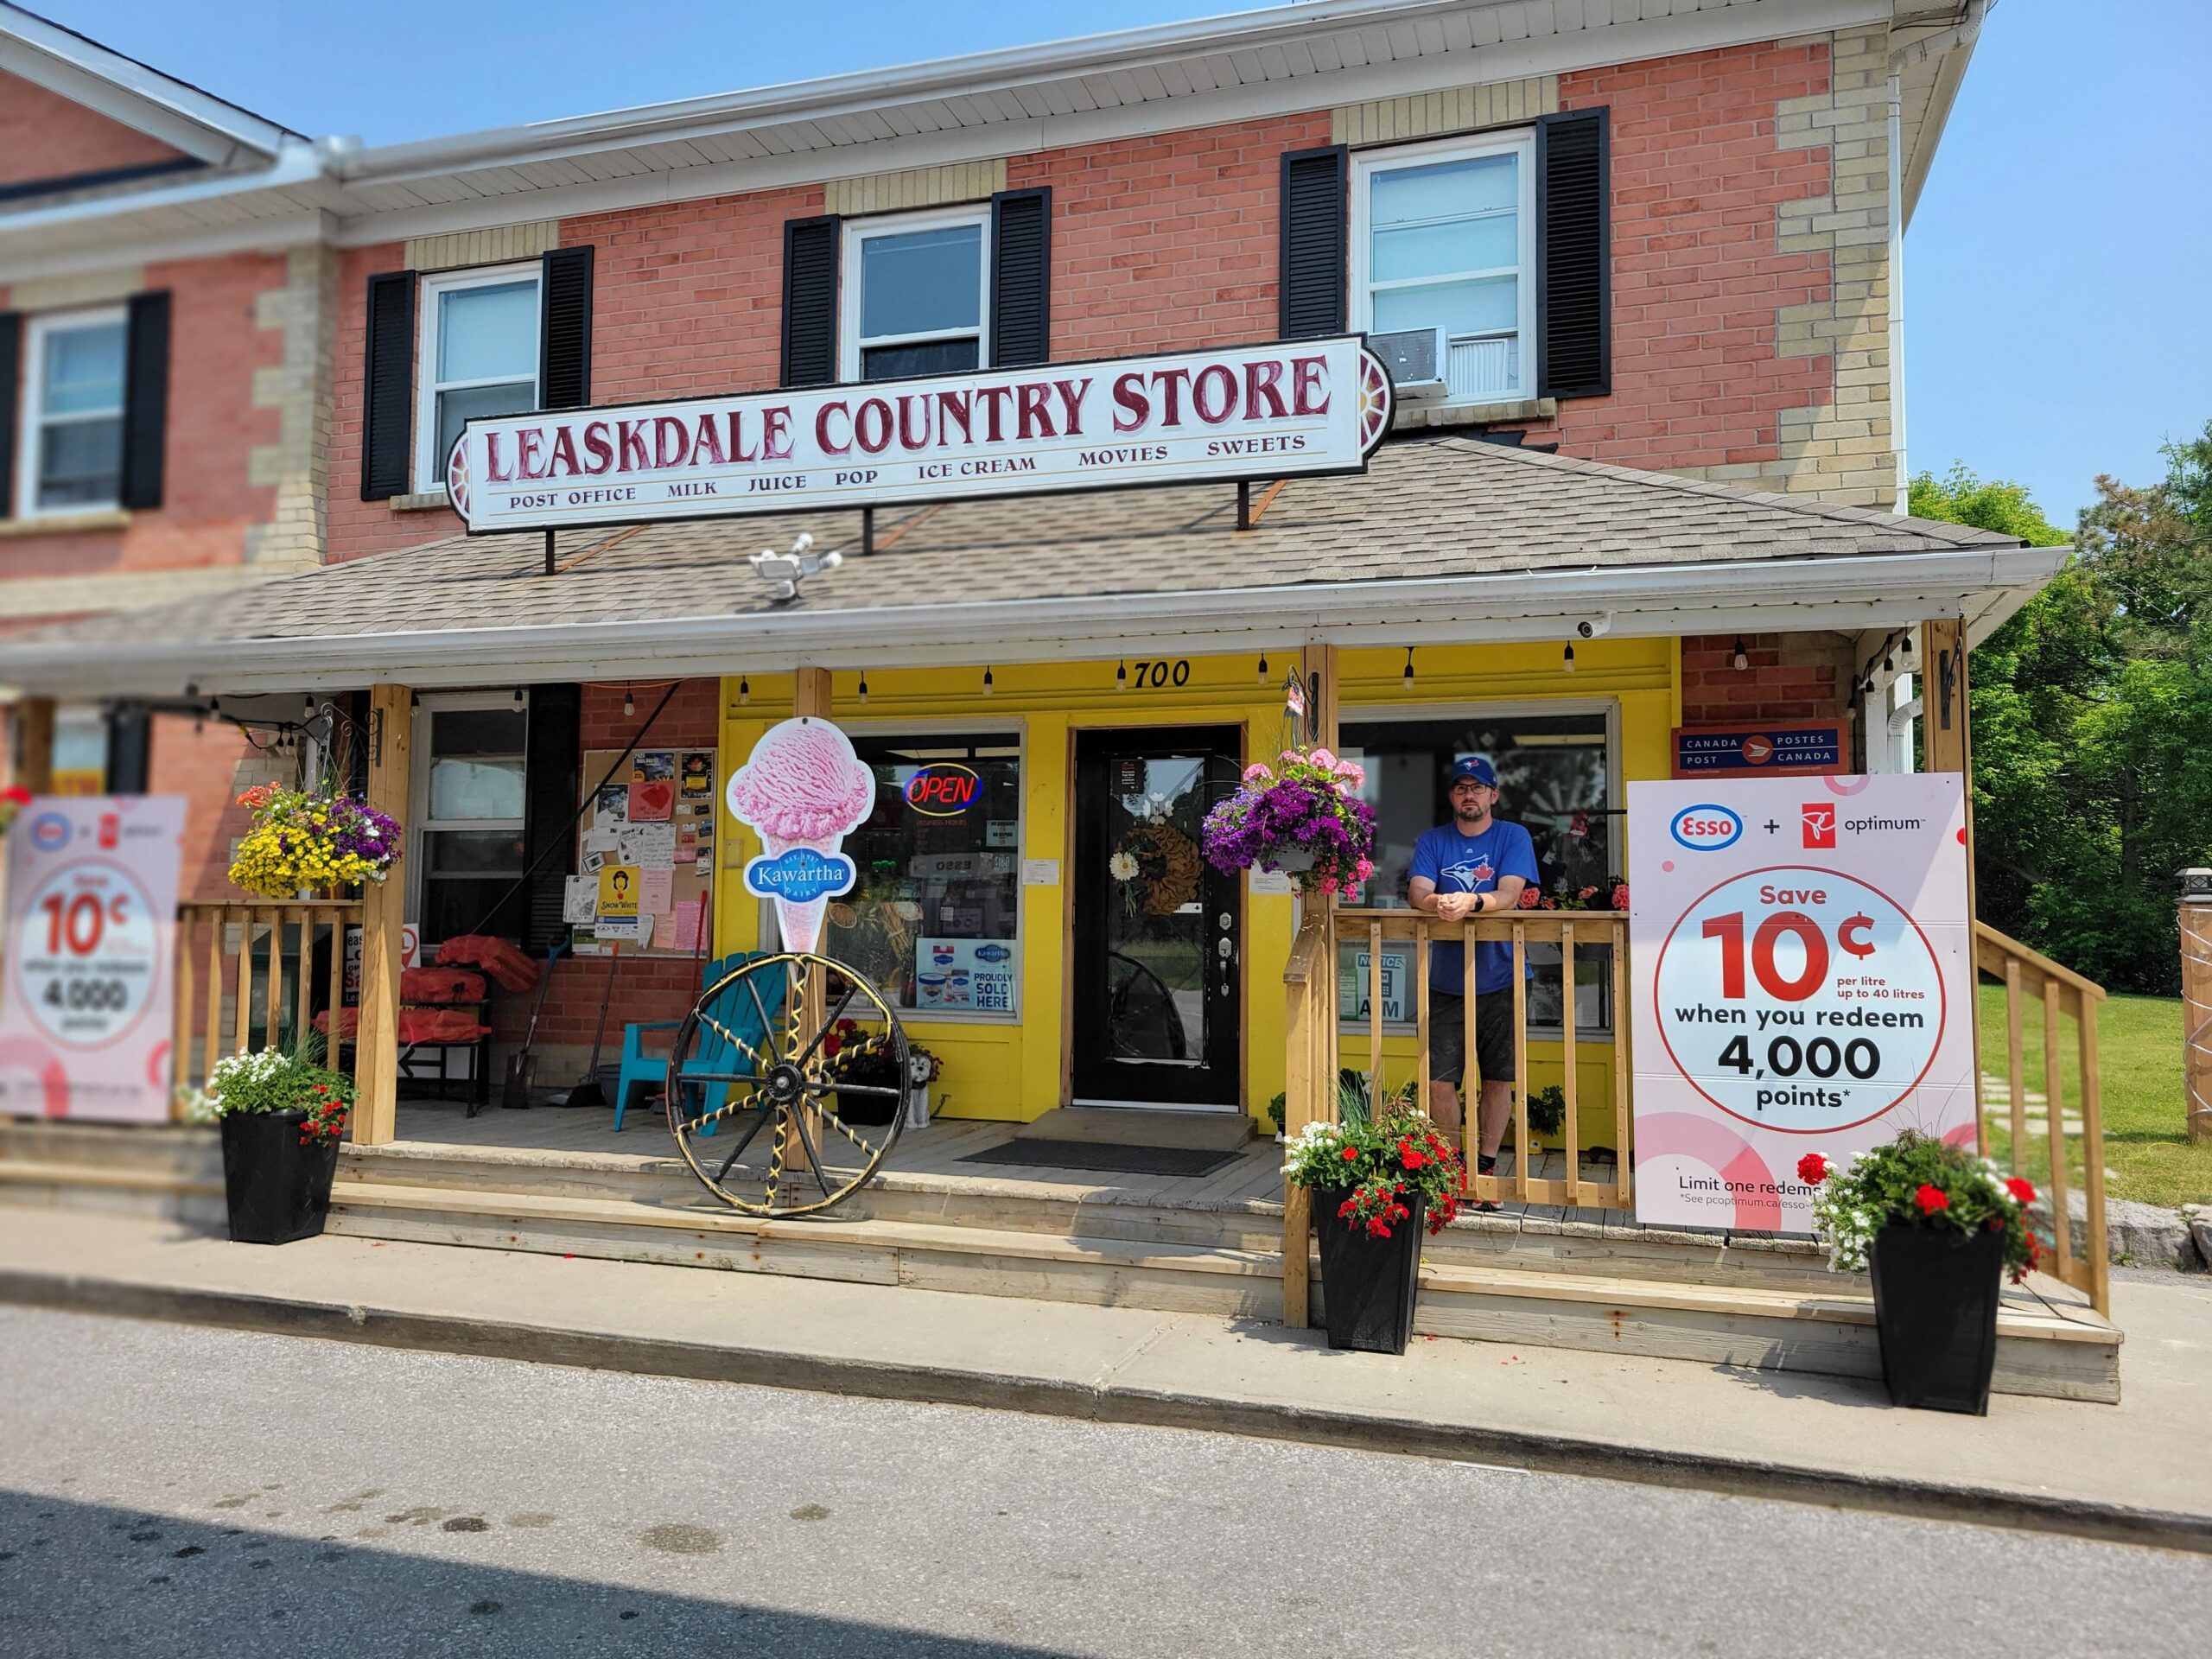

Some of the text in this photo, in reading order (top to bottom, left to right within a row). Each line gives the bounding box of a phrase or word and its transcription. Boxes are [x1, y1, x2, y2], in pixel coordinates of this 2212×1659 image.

[486, 354, 1332, 483] LEASKDALE COUNTRY STORE
[510, 435, 1306, 509] POST OFFICE MILK JUICE POP ICE CREAM MOVIES SWEETS
[1134, 660, 1190, 688] 700
[1687, 739, 1738, 748] CANADA
[1777, 735, 1824, 745] POSTES
[1687, 756, 1718, 765] POST
[1777, 752, 1831, 761] CANADA
[908, 777, 975, 803] OPEN
[1682, 817, 1732, 836] Esso
[758, 864, 843, 886] Kawartha
[785, 887, 817, 898] DAIRY
[1759, 886, 1827, 905] Save
[601, 901, 619, 910] SNOW
[1359, 956, 1405, 968] NICE
[974, 973, 1013, 982] PROUDLY
[1837, 976, 1885, 988] per litre
[976, 983, 1009, 995] SOLD
[1837, 988, 1925, 1000] up to 40 litres
[976, 996, 1009, 1008] HERE
[1359, 999, 1399, 1018] AM
[1675, 1003, 1924, 1030] when you redeem
[1718, 1035, 1881, 1080] 4,000
[1679, 1176, 1719, 1192] Limit
[1724, 1179, 1755, 1193] one
